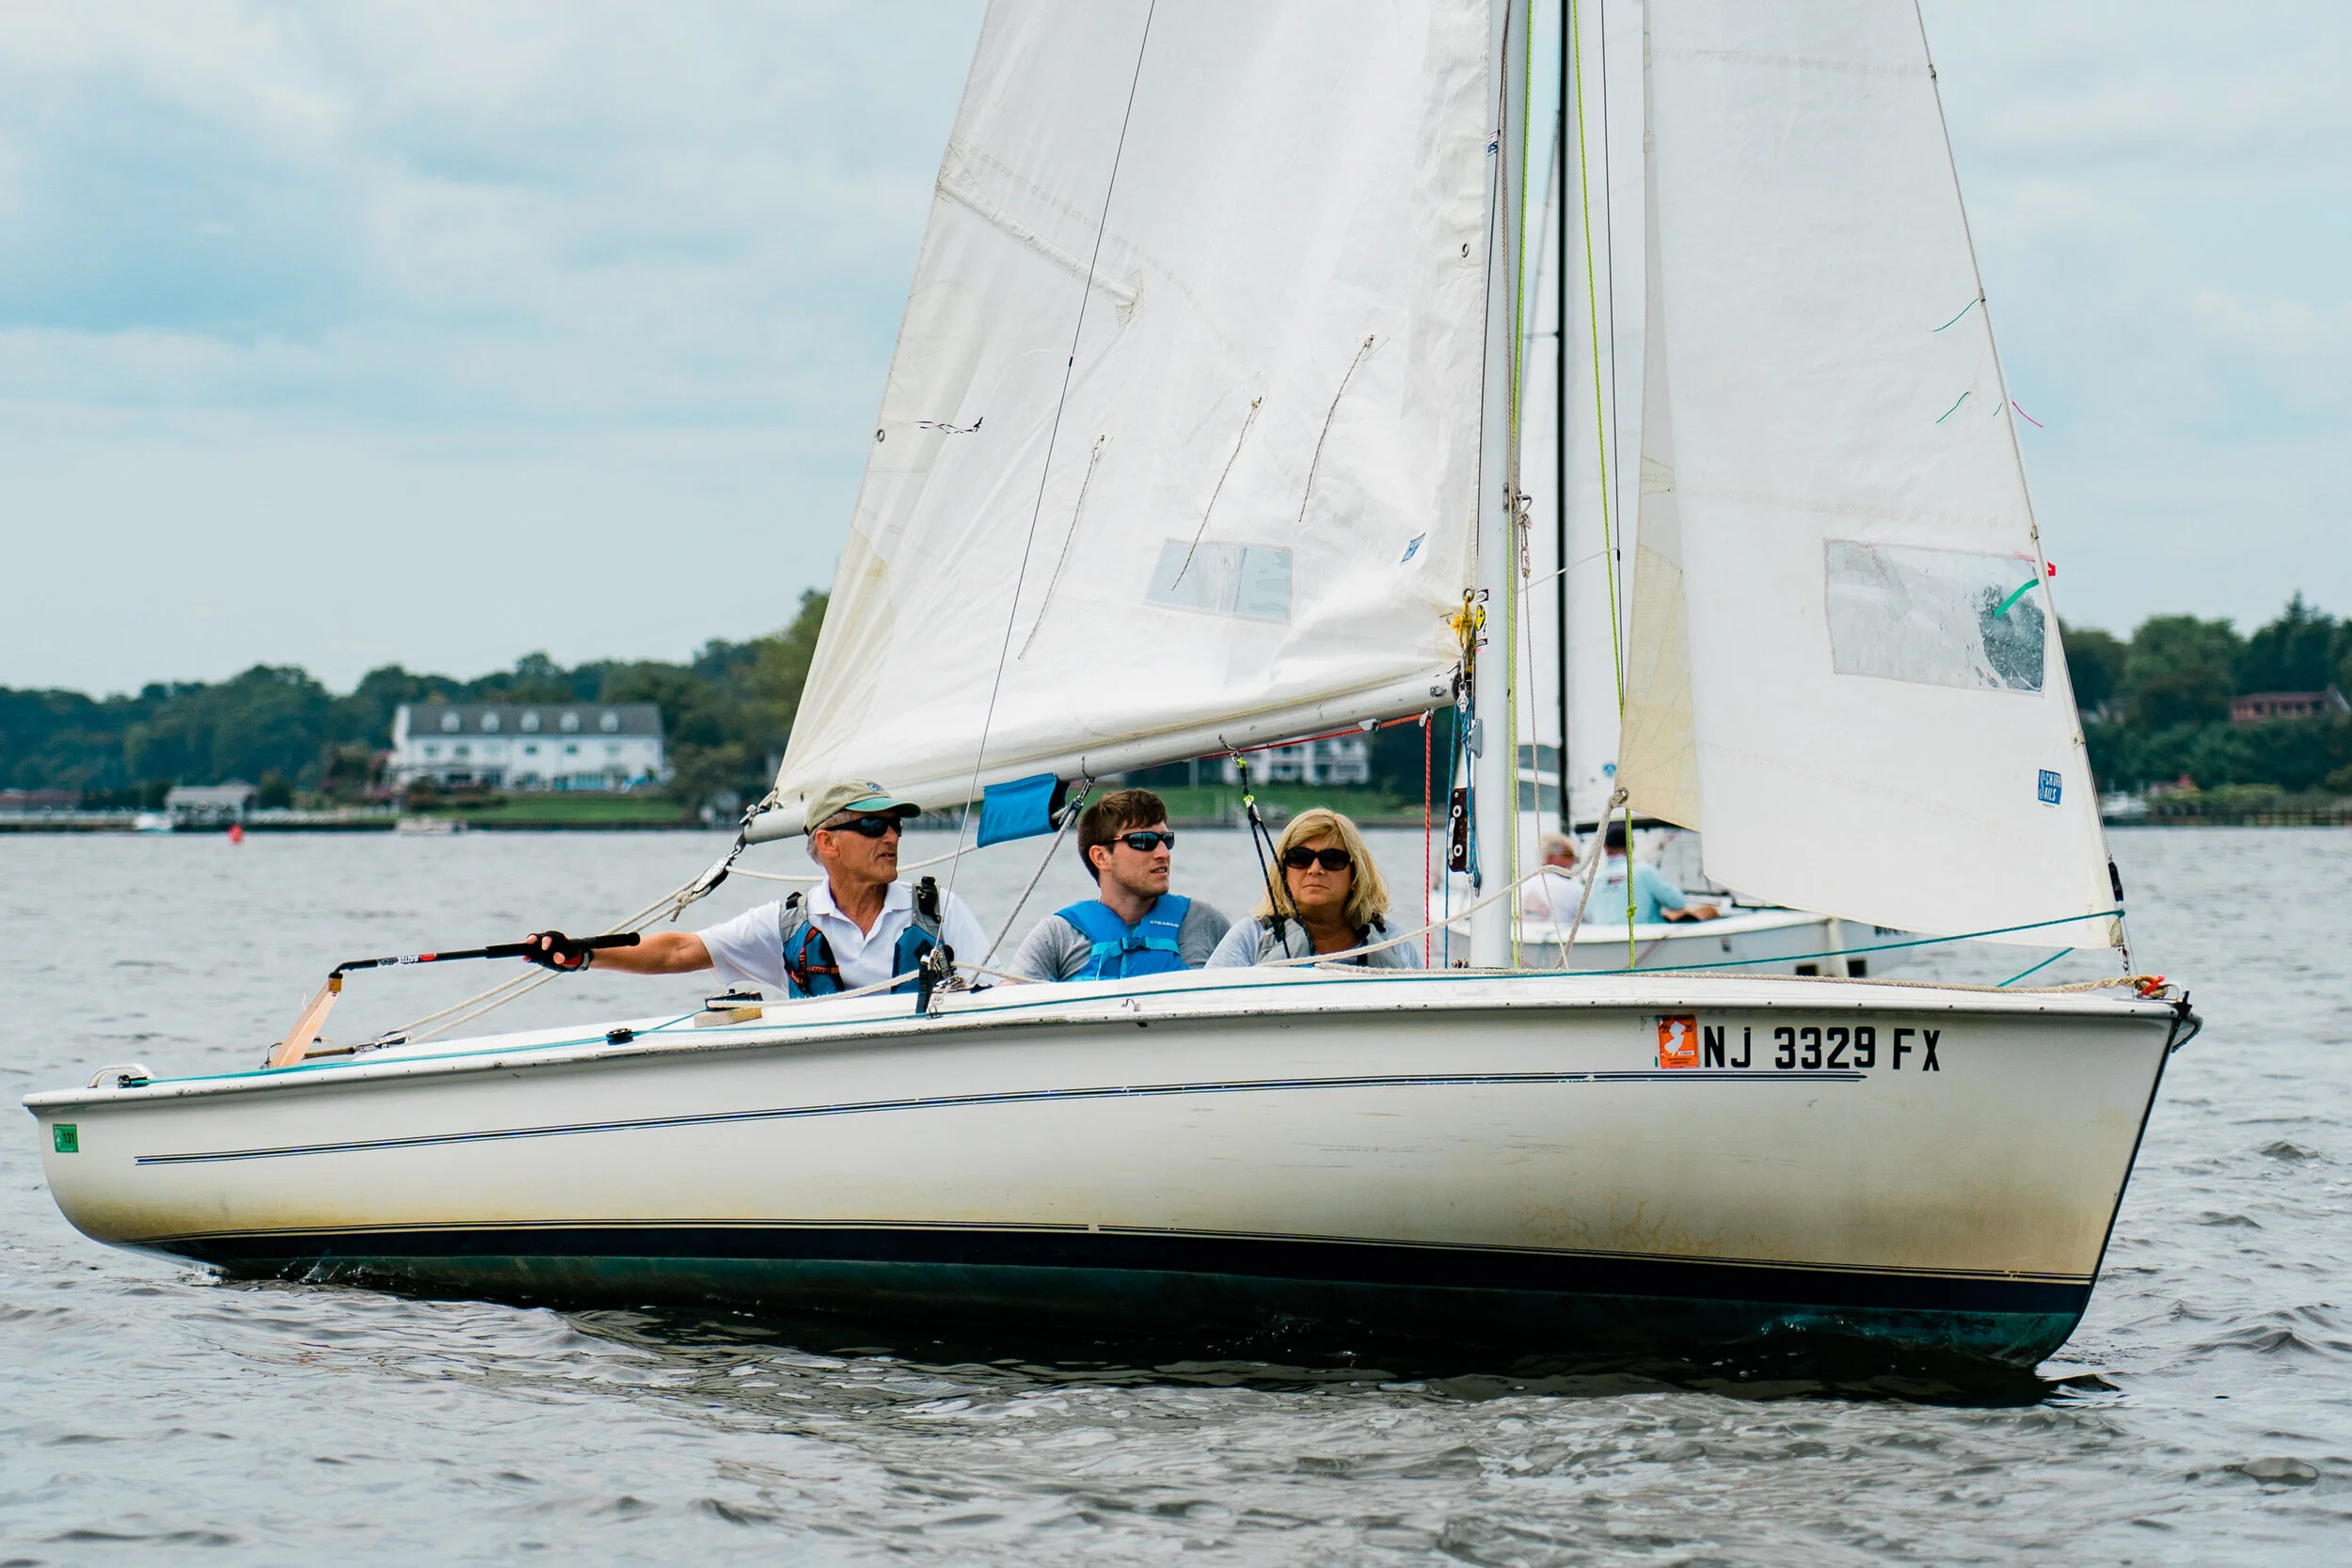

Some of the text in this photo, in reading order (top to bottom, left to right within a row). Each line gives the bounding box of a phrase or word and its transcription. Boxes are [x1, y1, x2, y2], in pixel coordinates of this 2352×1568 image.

[1704, 1026, 1941, 1071] NJ 3329 FX
[63, 1132, 74, 1144] 131
